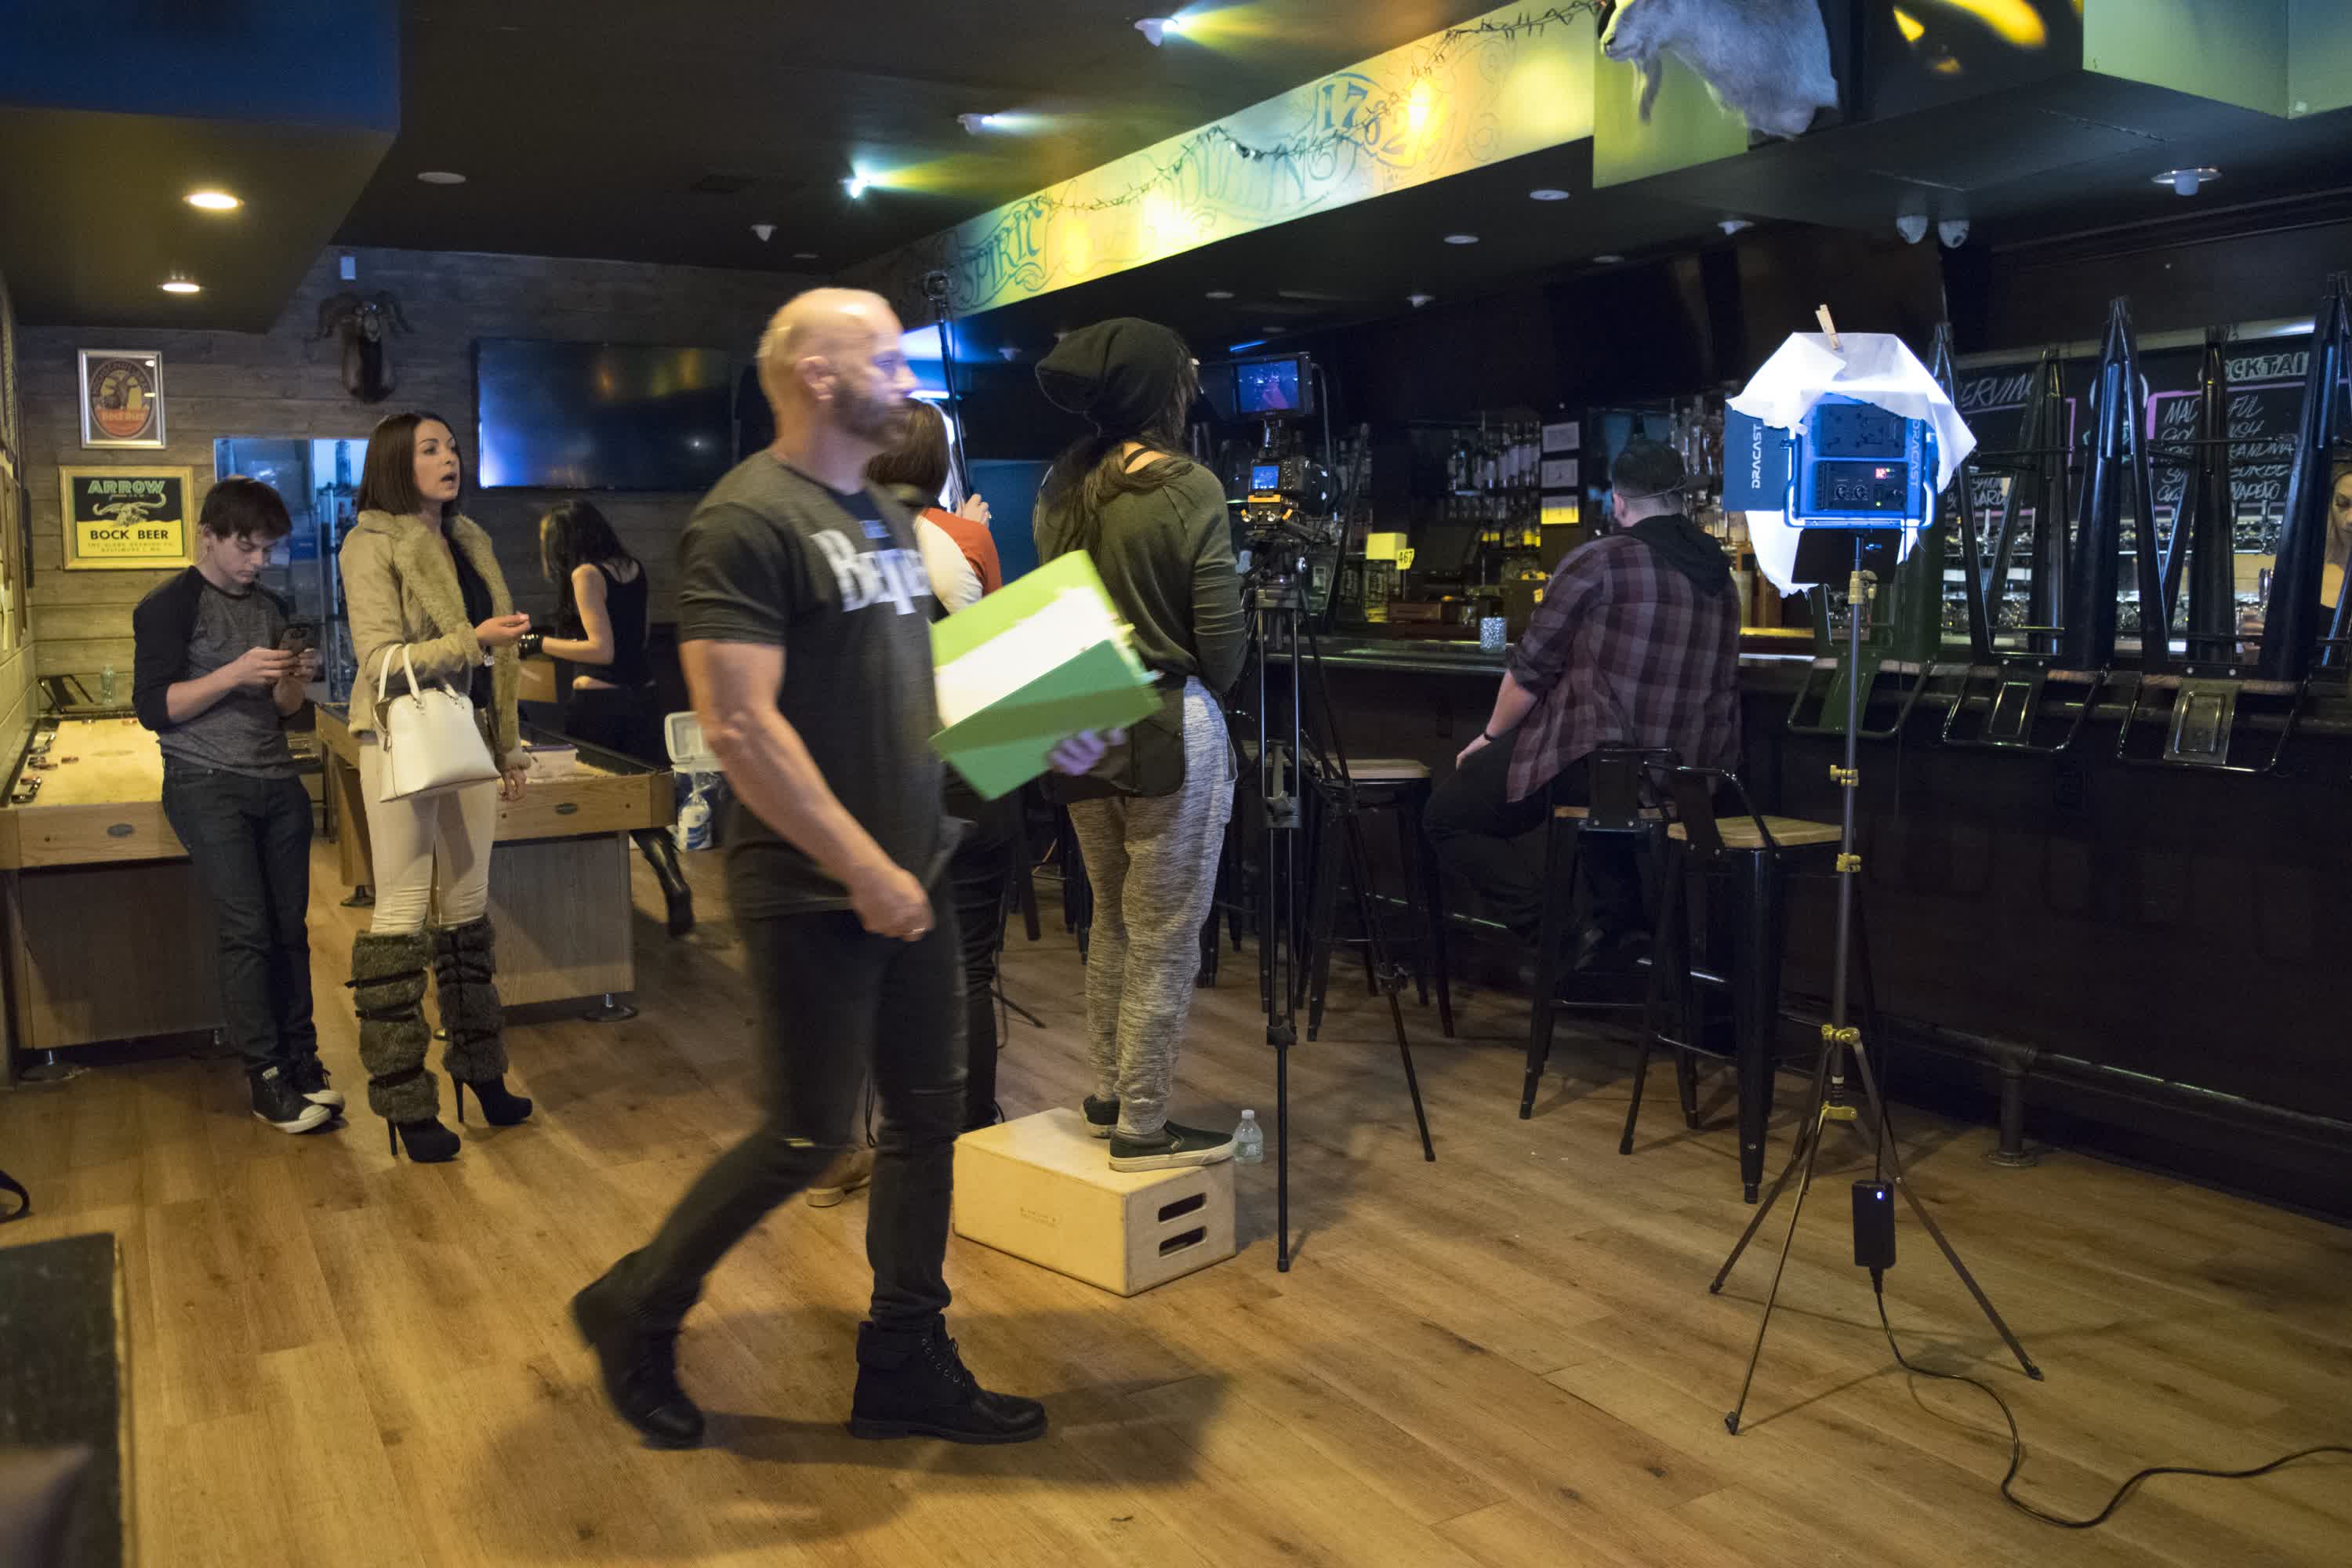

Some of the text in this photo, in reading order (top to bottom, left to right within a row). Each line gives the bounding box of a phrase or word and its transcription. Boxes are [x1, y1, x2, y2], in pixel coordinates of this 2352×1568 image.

[1751, 424, 1762, 489] DRACAST
[1910, 419, 1920, 488] DRACAST
[88, 480, 165, 494] ARROW
[90, 530, 169, 540] BOCK BEER
[1399, 551, 1414, 564] 467
